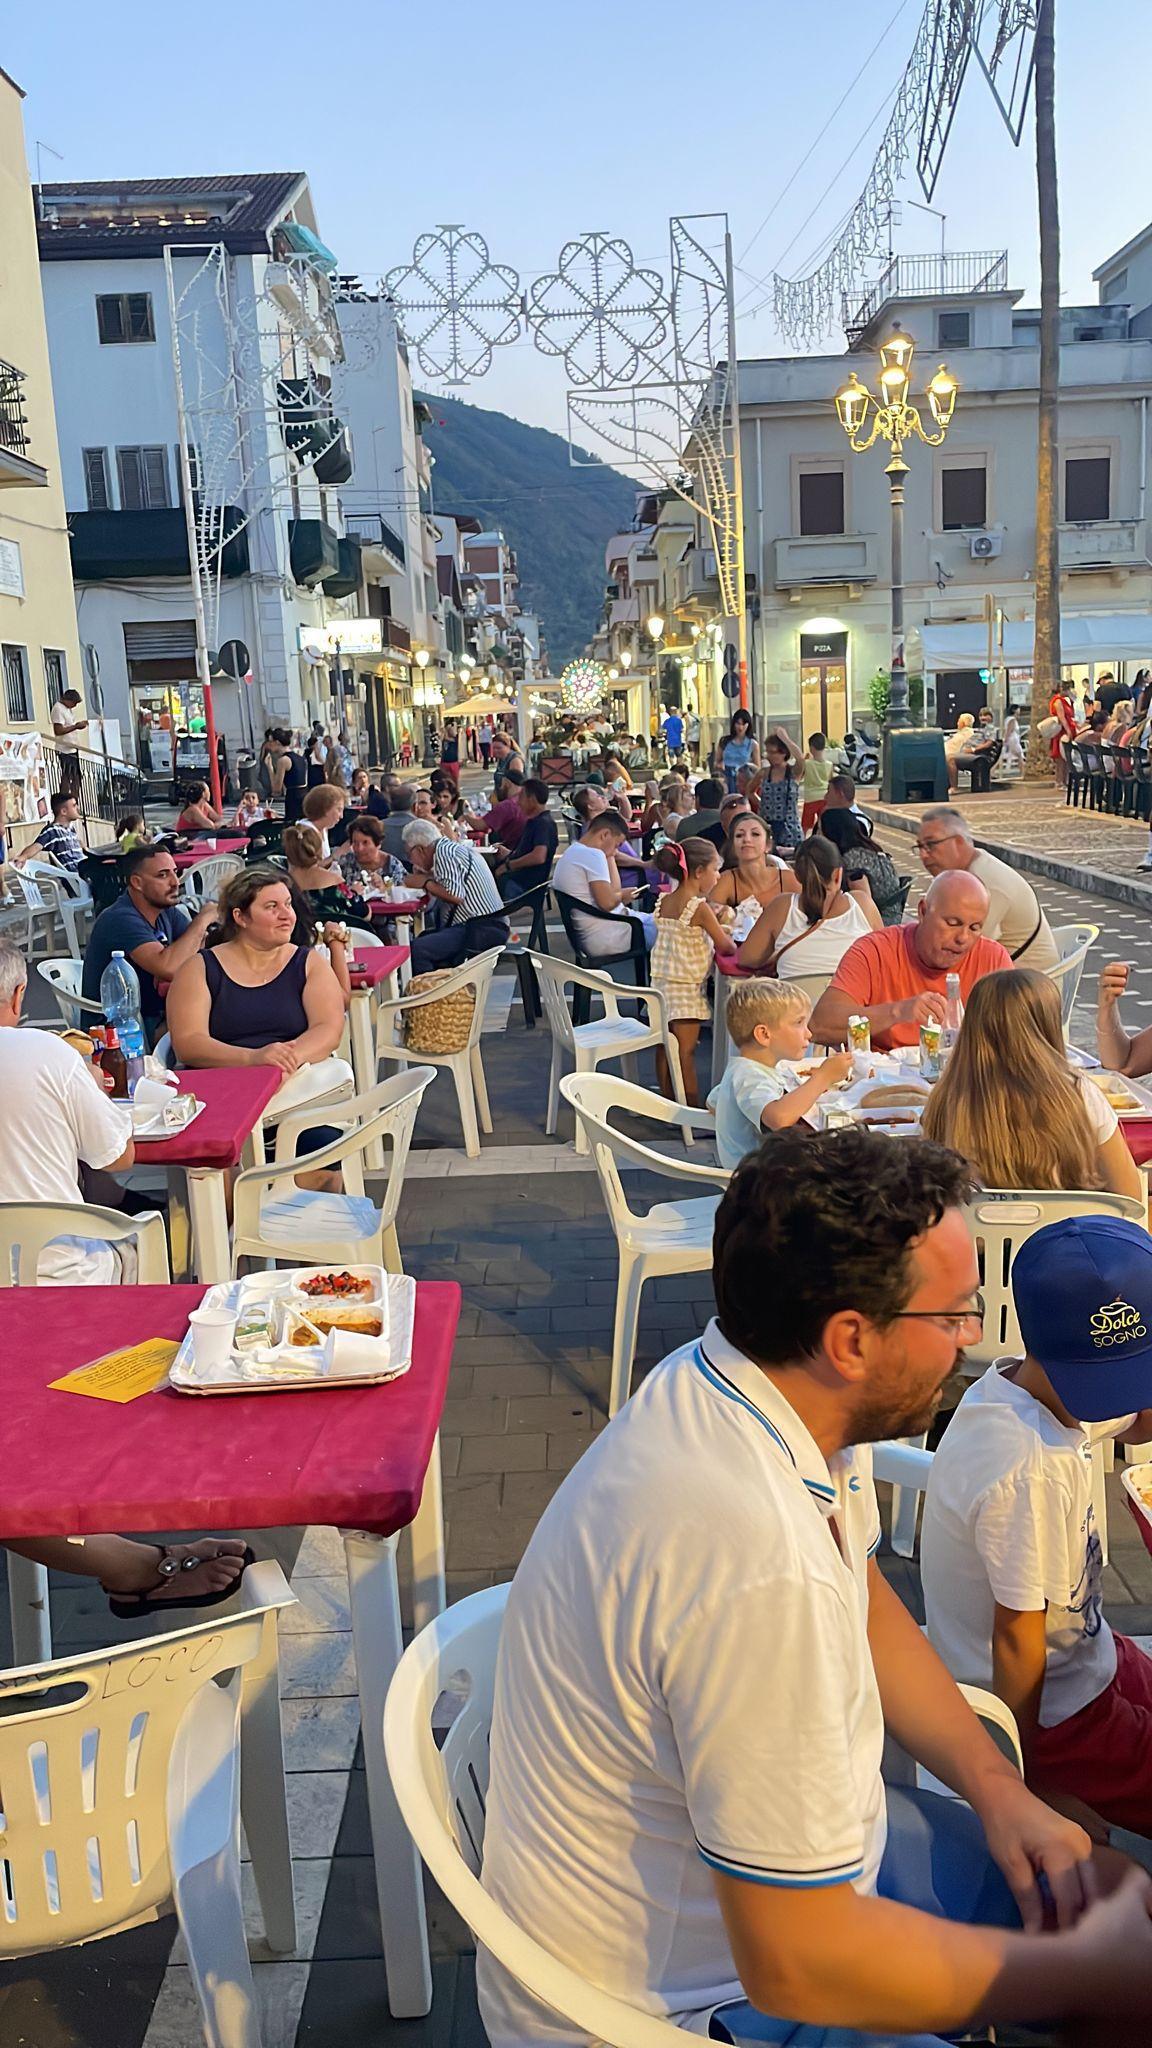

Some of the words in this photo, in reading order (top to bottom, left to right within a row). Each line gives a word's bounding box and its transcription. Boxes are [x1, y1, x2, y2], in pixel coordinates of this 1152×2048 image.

[1090, 1311, 1141, 1335] Dolce
[1093, 1325, 1147, 1348] SOGNO
[102, 1636, 223, 1699] LOCO
